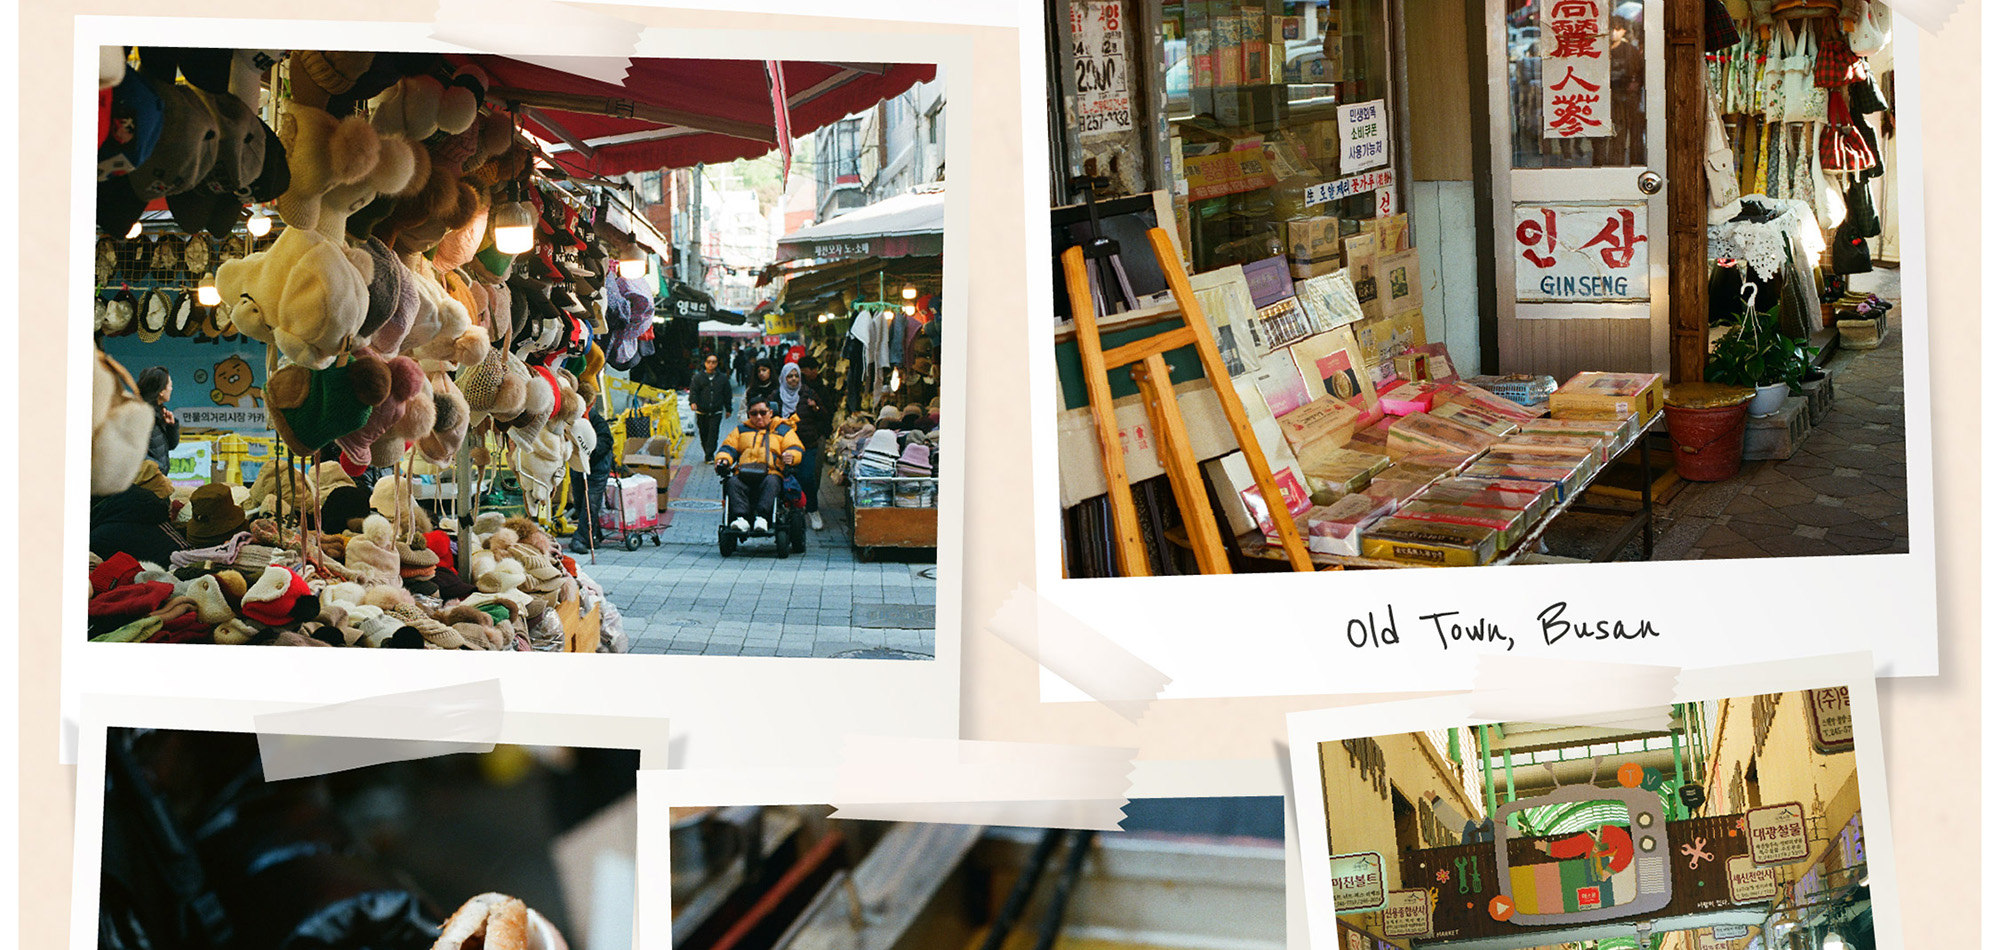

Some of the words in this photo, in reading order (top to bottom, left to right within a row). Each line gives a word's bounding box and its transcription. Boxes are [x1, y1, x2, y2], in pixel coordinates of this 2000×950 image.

[1350, 105, 1376, 123] 민생회복
[1350, 123, 1377, 140] 소비쿠폰
[1349, 140, 1382, 159] 사용가능처
[1540, 275, 1628, 297] GINSENG
[183, 412, 246, 423] 만물의거리시장
[1753, 822, 1801, 841] 대광철물
